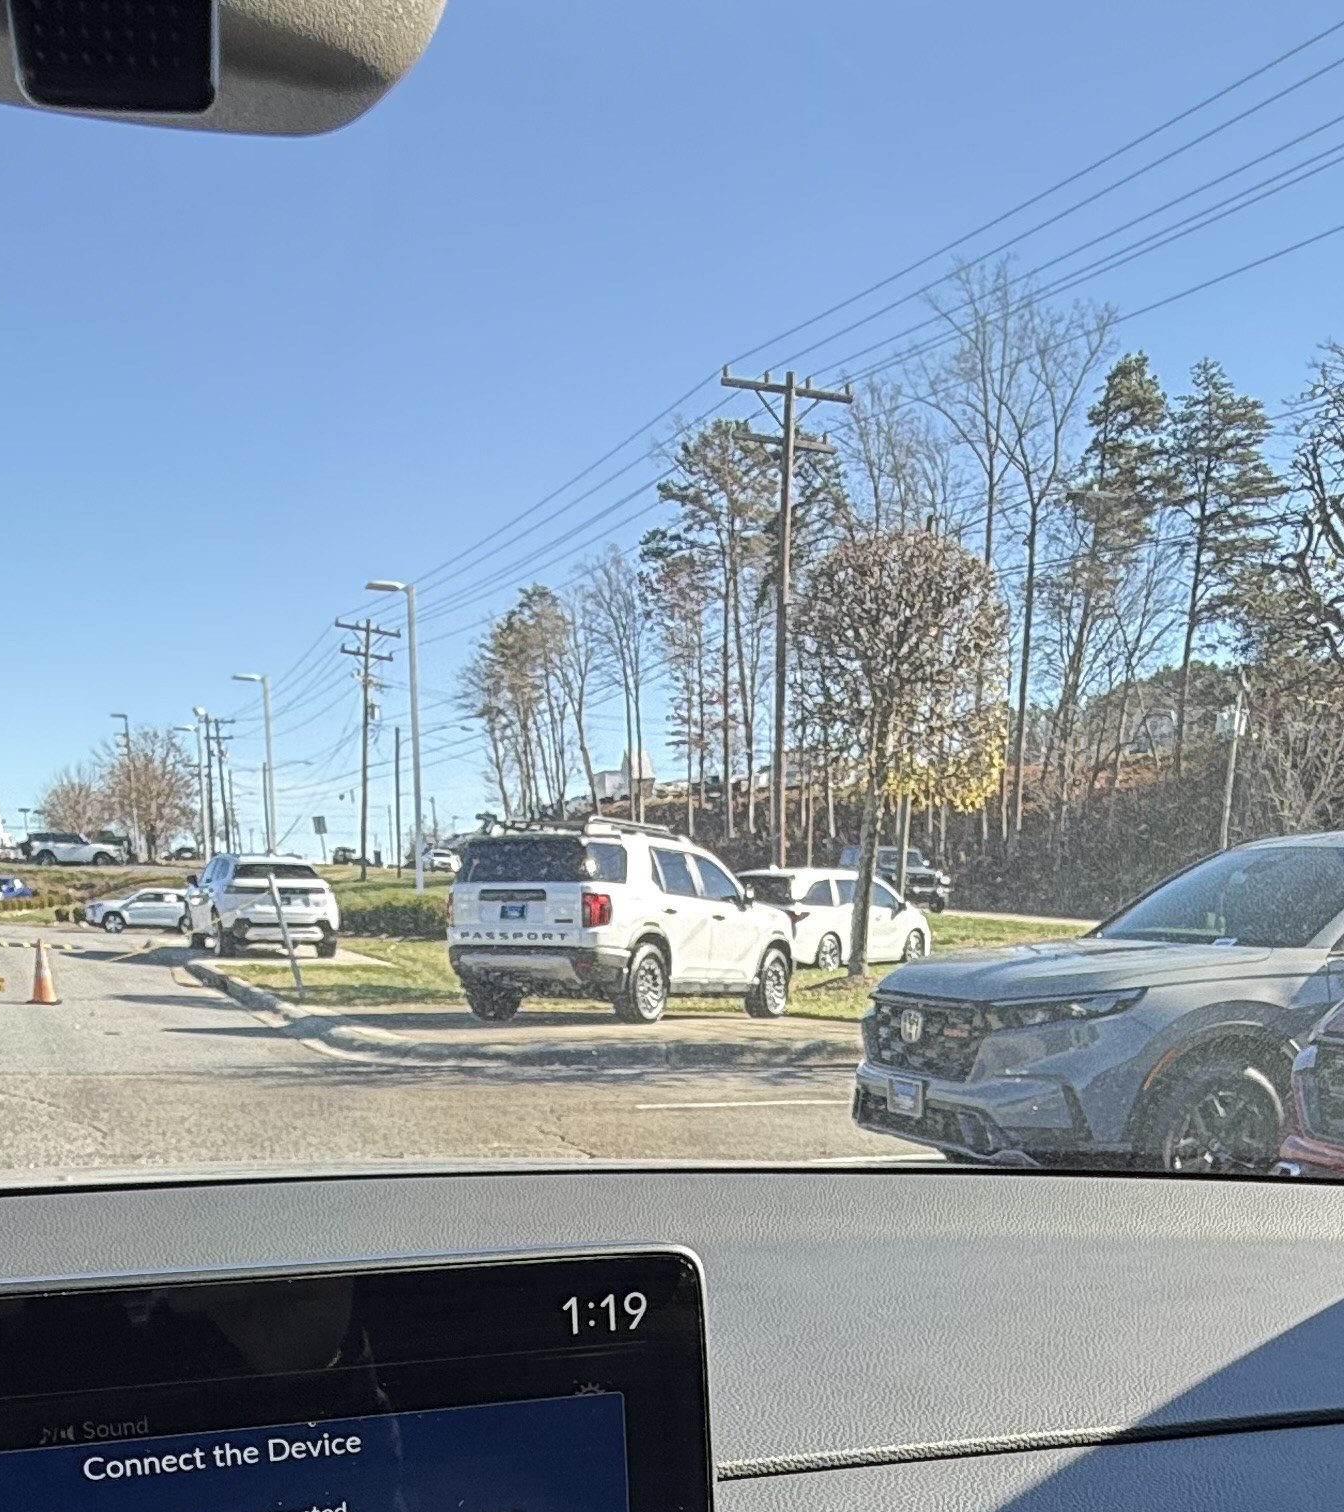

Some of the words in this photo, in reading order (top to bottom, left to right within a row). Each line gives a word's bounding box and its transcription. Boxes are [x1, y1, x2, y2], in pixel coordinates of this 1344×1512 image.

[460, 931, 568, 941] PASSPORT
[562, 1291, 647, 1335] 1:19
[82, 1416, 149, 1440] Sound
[83, 1447, 206, 1481] Connect
[213, 1442, 259, 1468] the
[268, 1433, 362, 1463] Device
